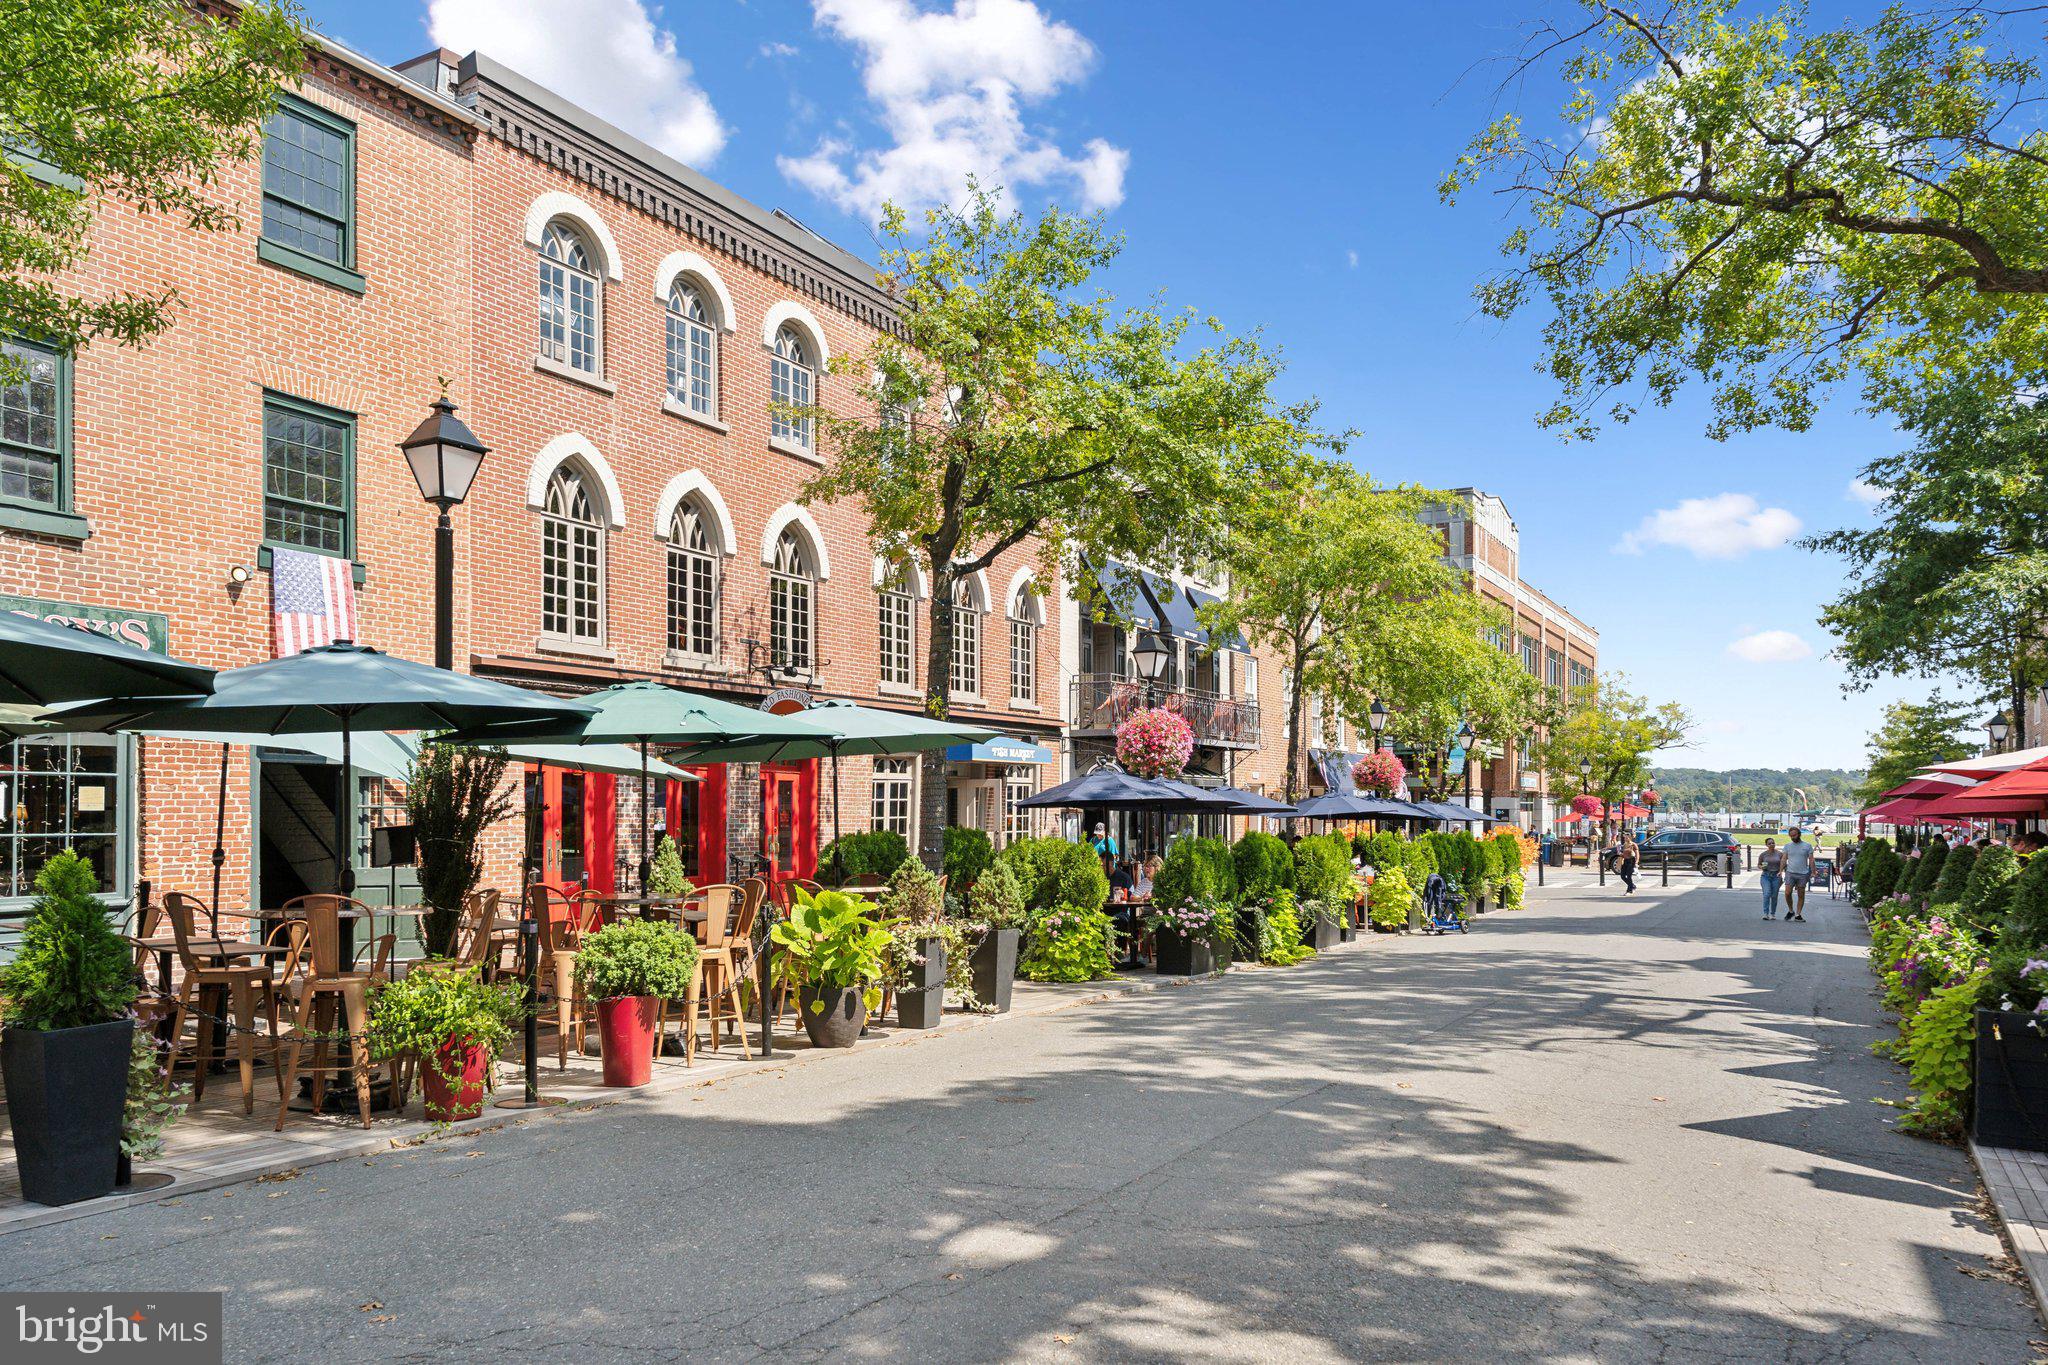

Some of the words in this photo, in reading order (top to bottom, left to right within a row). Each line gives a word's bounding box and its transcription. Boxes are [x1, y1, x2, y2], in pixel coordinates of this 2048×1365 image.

[762, 696, 775, 712] OLD
[777, 689, 810, 707] FASHIONE
[1009, 748, 1036, 761] MARKET
